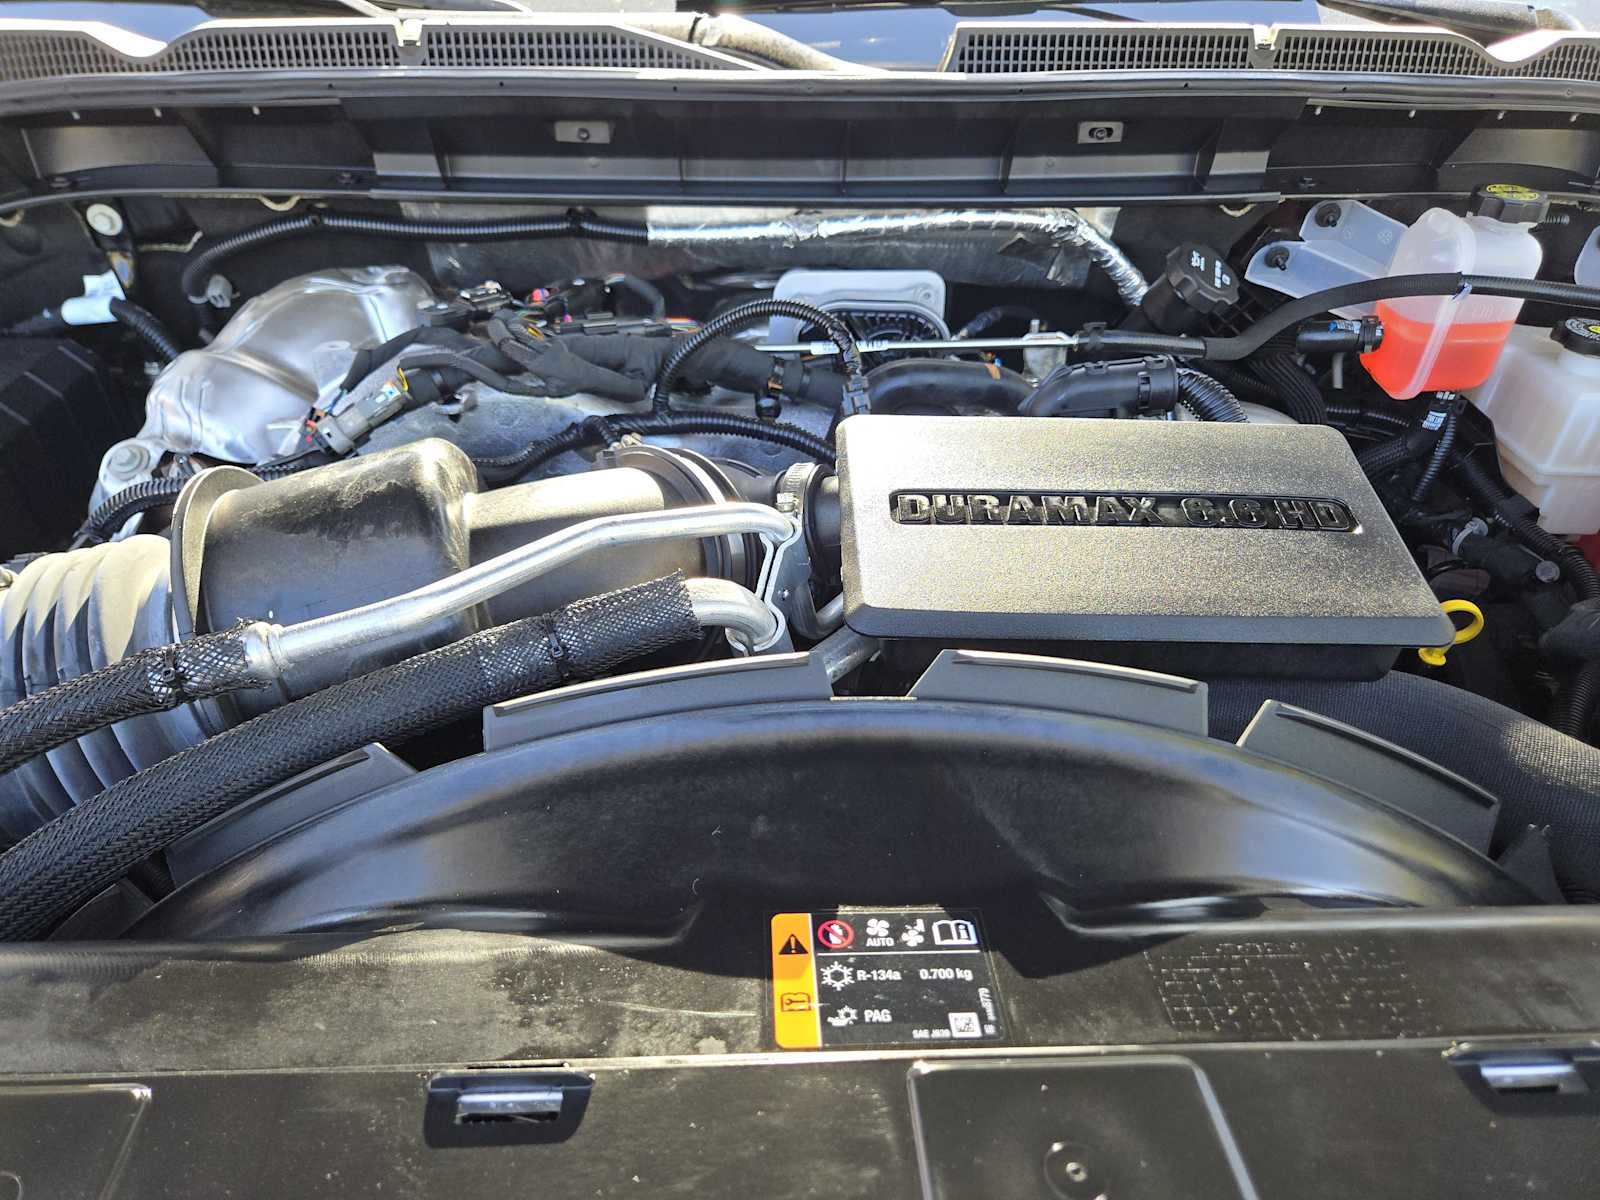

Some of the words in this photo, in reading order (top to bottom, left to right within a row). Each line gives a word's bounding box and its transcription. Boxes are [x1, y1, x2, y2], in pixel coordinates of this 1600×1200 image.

[897, 494, 1164, 523] DURAMAX
[1181, 498, 1268, 528] 6.6
[1273, 499, 1351, 529] HD
[866, 937, 895, 946] AUTO
[856, 969, 902, 981] R-134a
[919, 968, 954, 980] 0.700
[956, 967, 973, 981] kg
[864, 1009, 892, 1022] PAG
